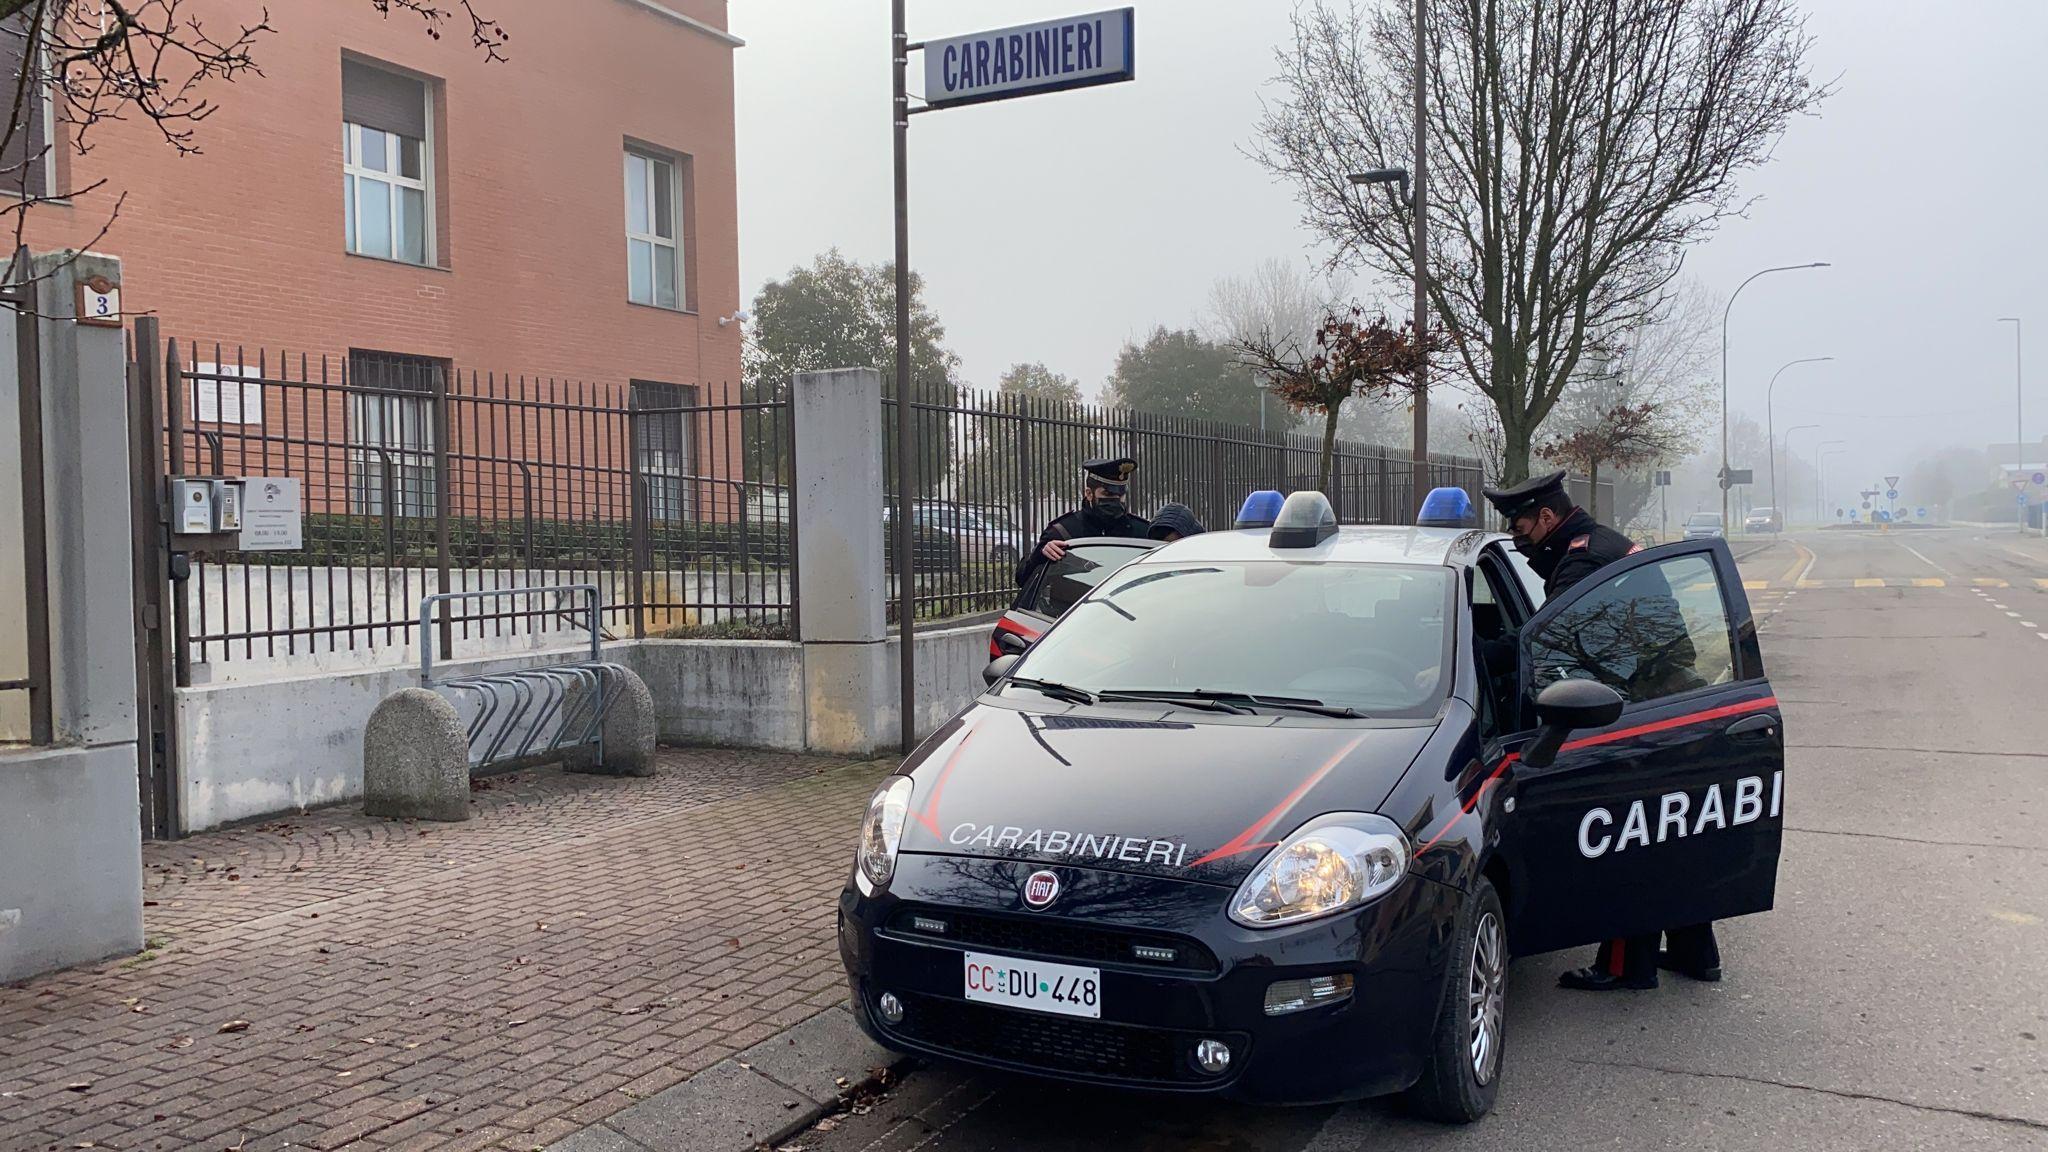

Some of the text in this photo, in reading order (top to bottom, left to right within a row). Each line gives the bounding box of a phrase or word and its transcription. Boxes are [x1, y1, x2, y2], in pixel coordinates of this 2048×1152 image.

[943, 20, 1102, 92] CARABINIERI
[97, 296, 108, 315] 3
[1578, 770, 1783, 859] CARABI
[949, 822, 1187, 867] CARABINIERI
[1031, 881, 1052, 897] FIAT
[1052, 975, 1096, 1007] 448
